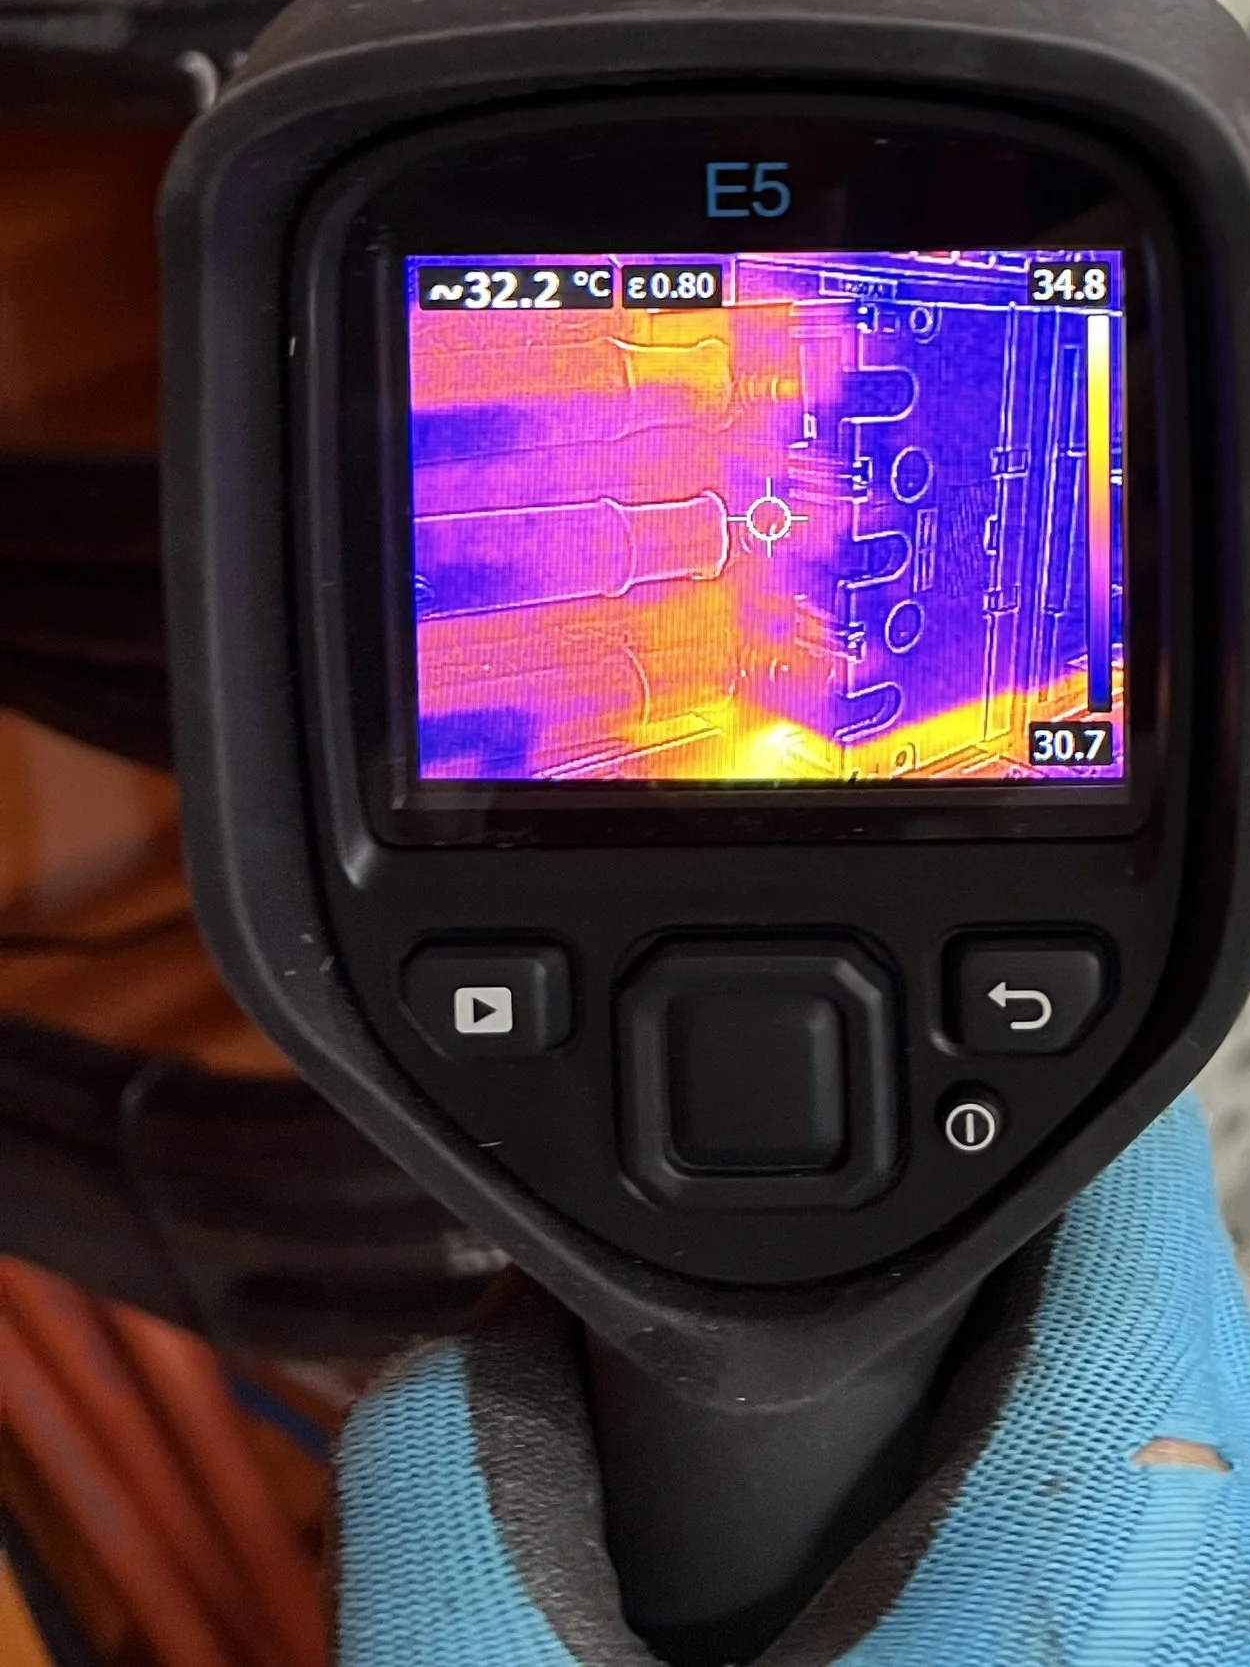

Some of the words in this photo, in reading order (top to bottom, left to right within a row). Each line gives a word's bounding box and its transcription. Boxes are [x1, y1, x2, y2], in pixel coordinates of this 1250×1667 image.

[706, 162, 791, 217] E5
[571, 270, 611, 298] °C
[651, 271, 715, 299] 0.80
[1031, 268, 1107, 301] 34.8
[1033, 729, 1107, 761] 30.7
